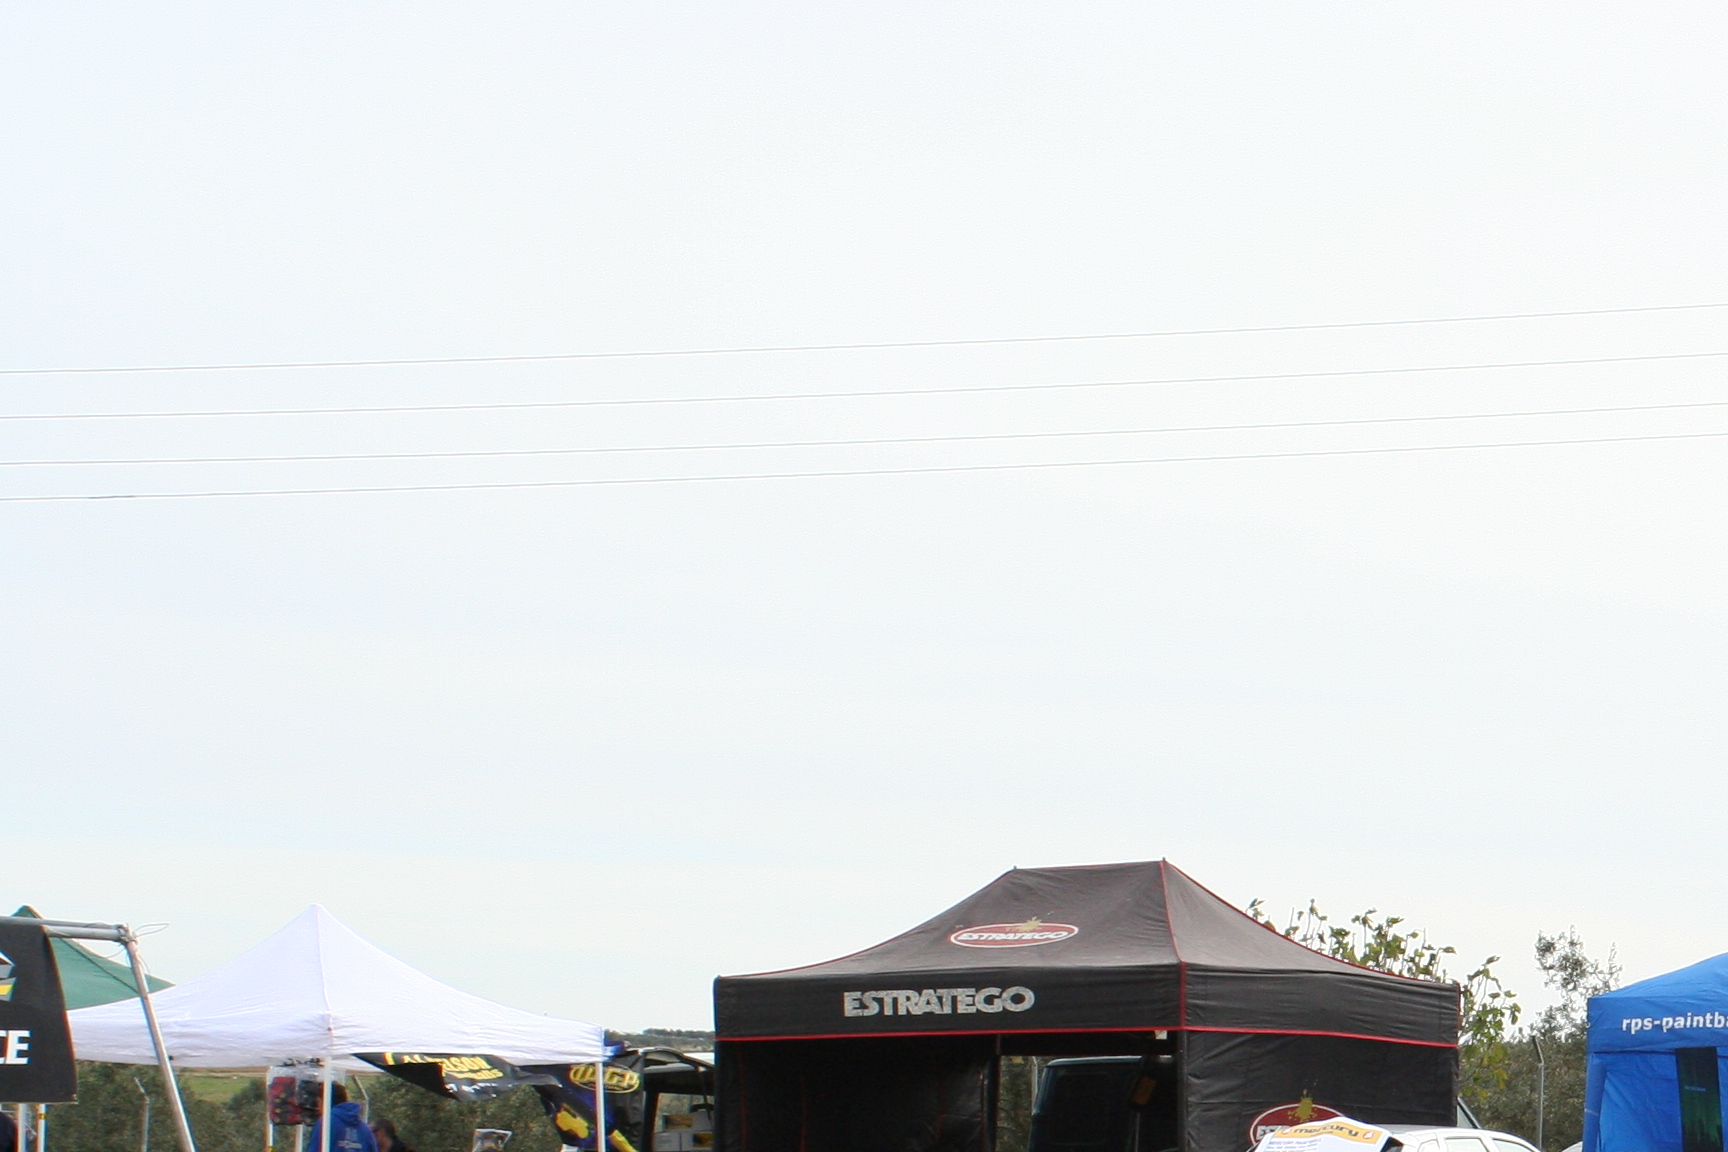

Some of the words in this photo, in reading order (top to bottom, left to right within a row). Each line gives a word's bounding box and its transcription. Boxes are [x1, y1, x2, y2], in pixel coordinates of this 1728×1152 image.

[957, 930, 1070, 942] ESTRATEGO
[843, 986, 1036, 1017] ESTRATEGO
[0, 1030, 31, 1065] E
